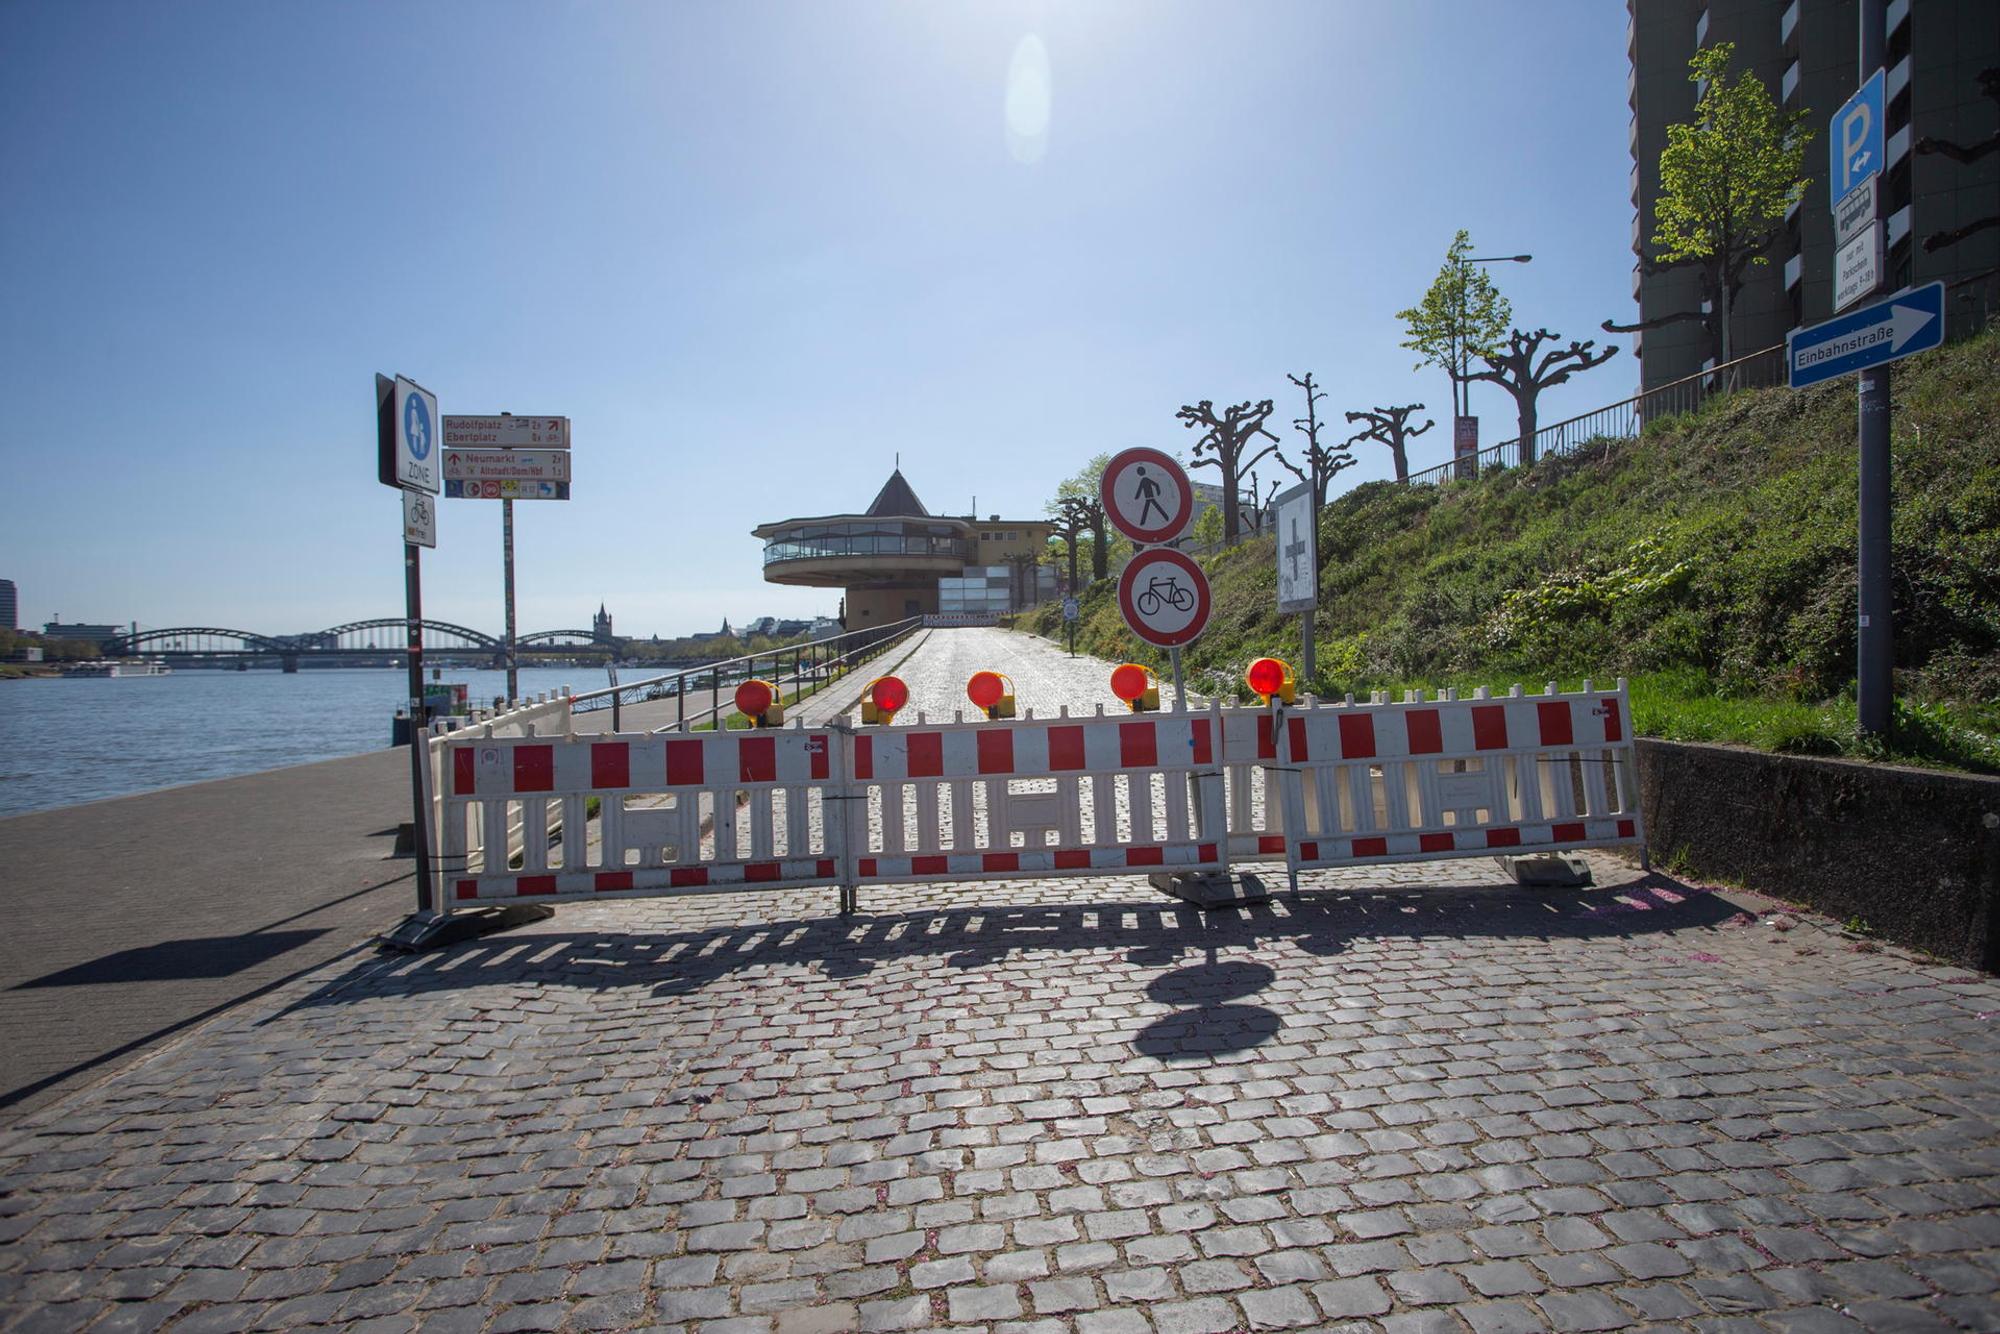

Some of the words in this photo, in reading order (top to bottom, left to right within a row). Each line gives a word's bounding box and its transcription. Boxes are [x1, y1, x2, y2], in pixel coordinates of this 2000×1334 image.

[1843, 103, 1870, 190] P
[1842, 257, 1868, 282] Parkschein
[1798, 327, 1894, 367] Einbahnstraße
[446, 419, 502, 431] Rudolfplatz
[446, 432, 497, 442] Ebertplatz
[466, 453, 515, 464] Neumarkt
[408, 461, 430, 484] ZONE
[480, 466, 544, 477] Altstadt/Dom/Hbf
